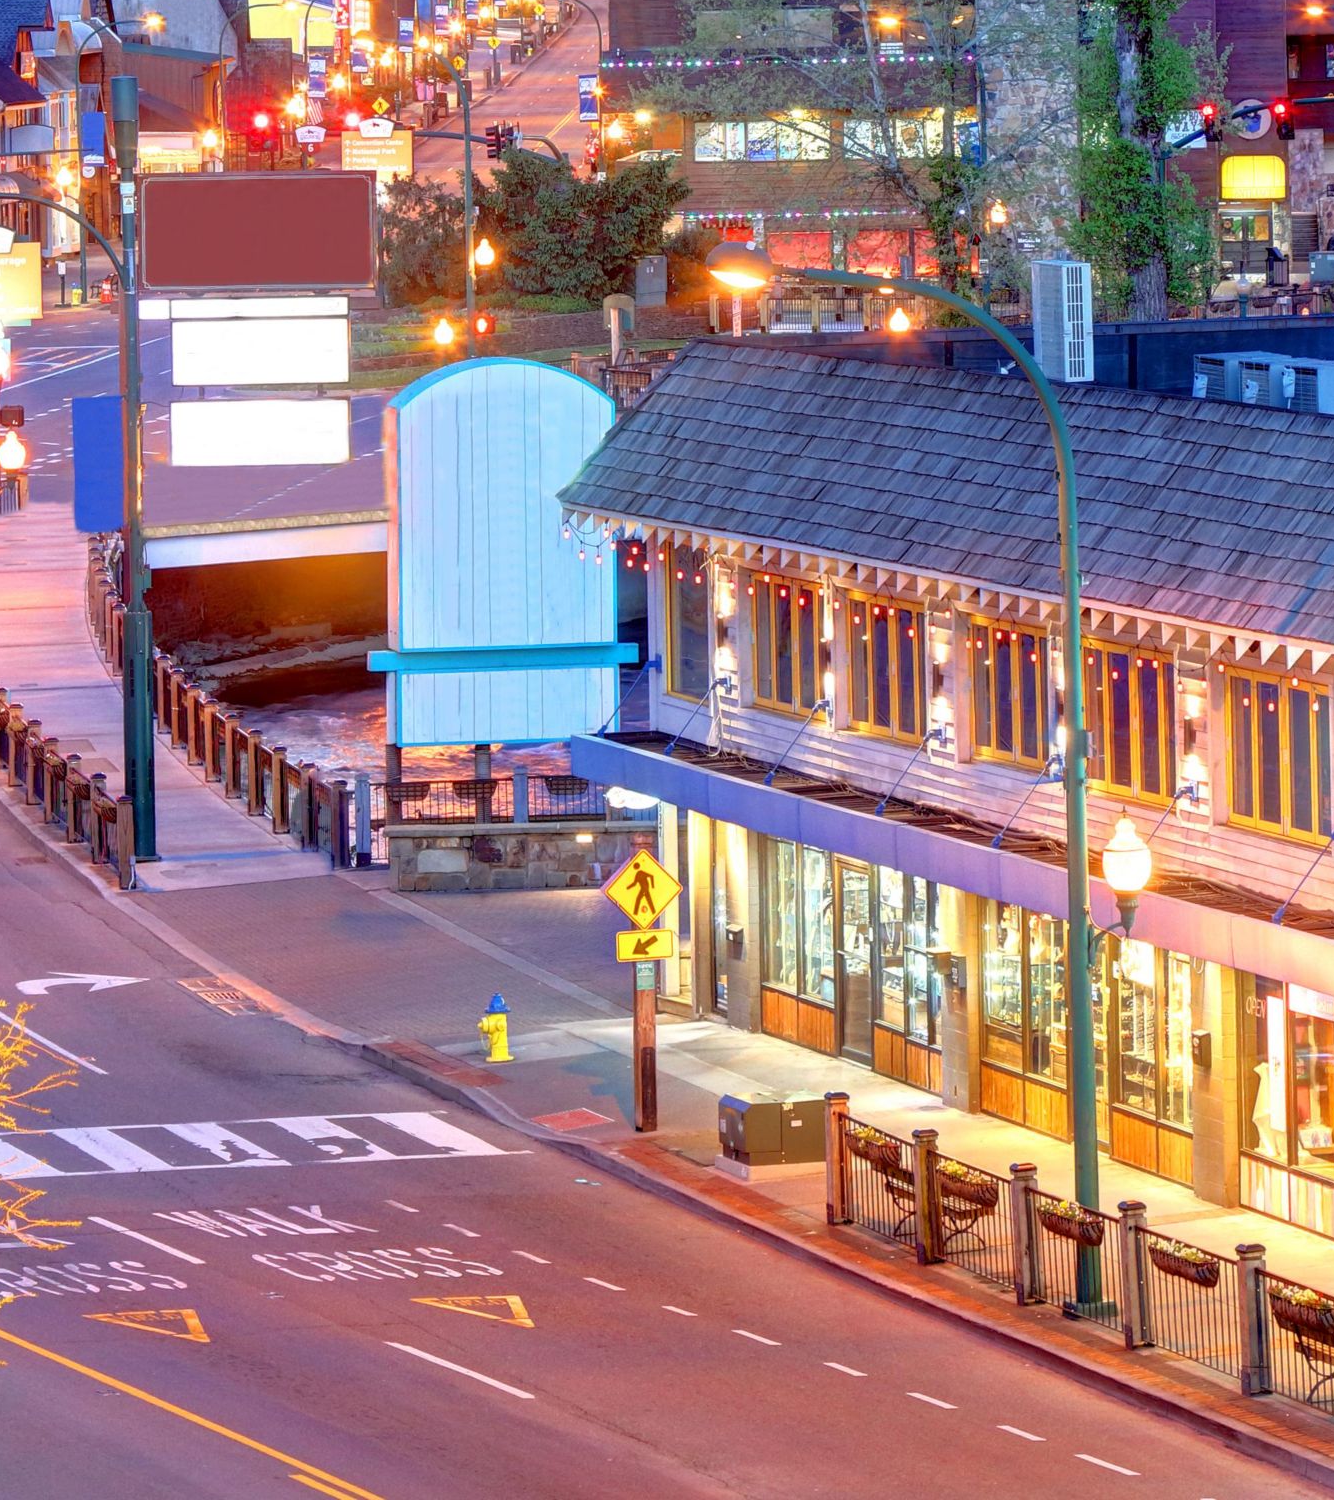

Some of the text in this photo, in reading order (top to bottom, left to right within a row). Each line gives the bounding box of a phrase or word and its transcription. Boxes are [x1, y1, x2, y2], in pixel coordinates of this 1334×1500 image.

[307, 143, 314, 153] 6
[1246, 996, 1267, 1019] OPEN
[152, 1205, 379, 1238] WALK
[252, 1247, 504, 1282] CROSS
